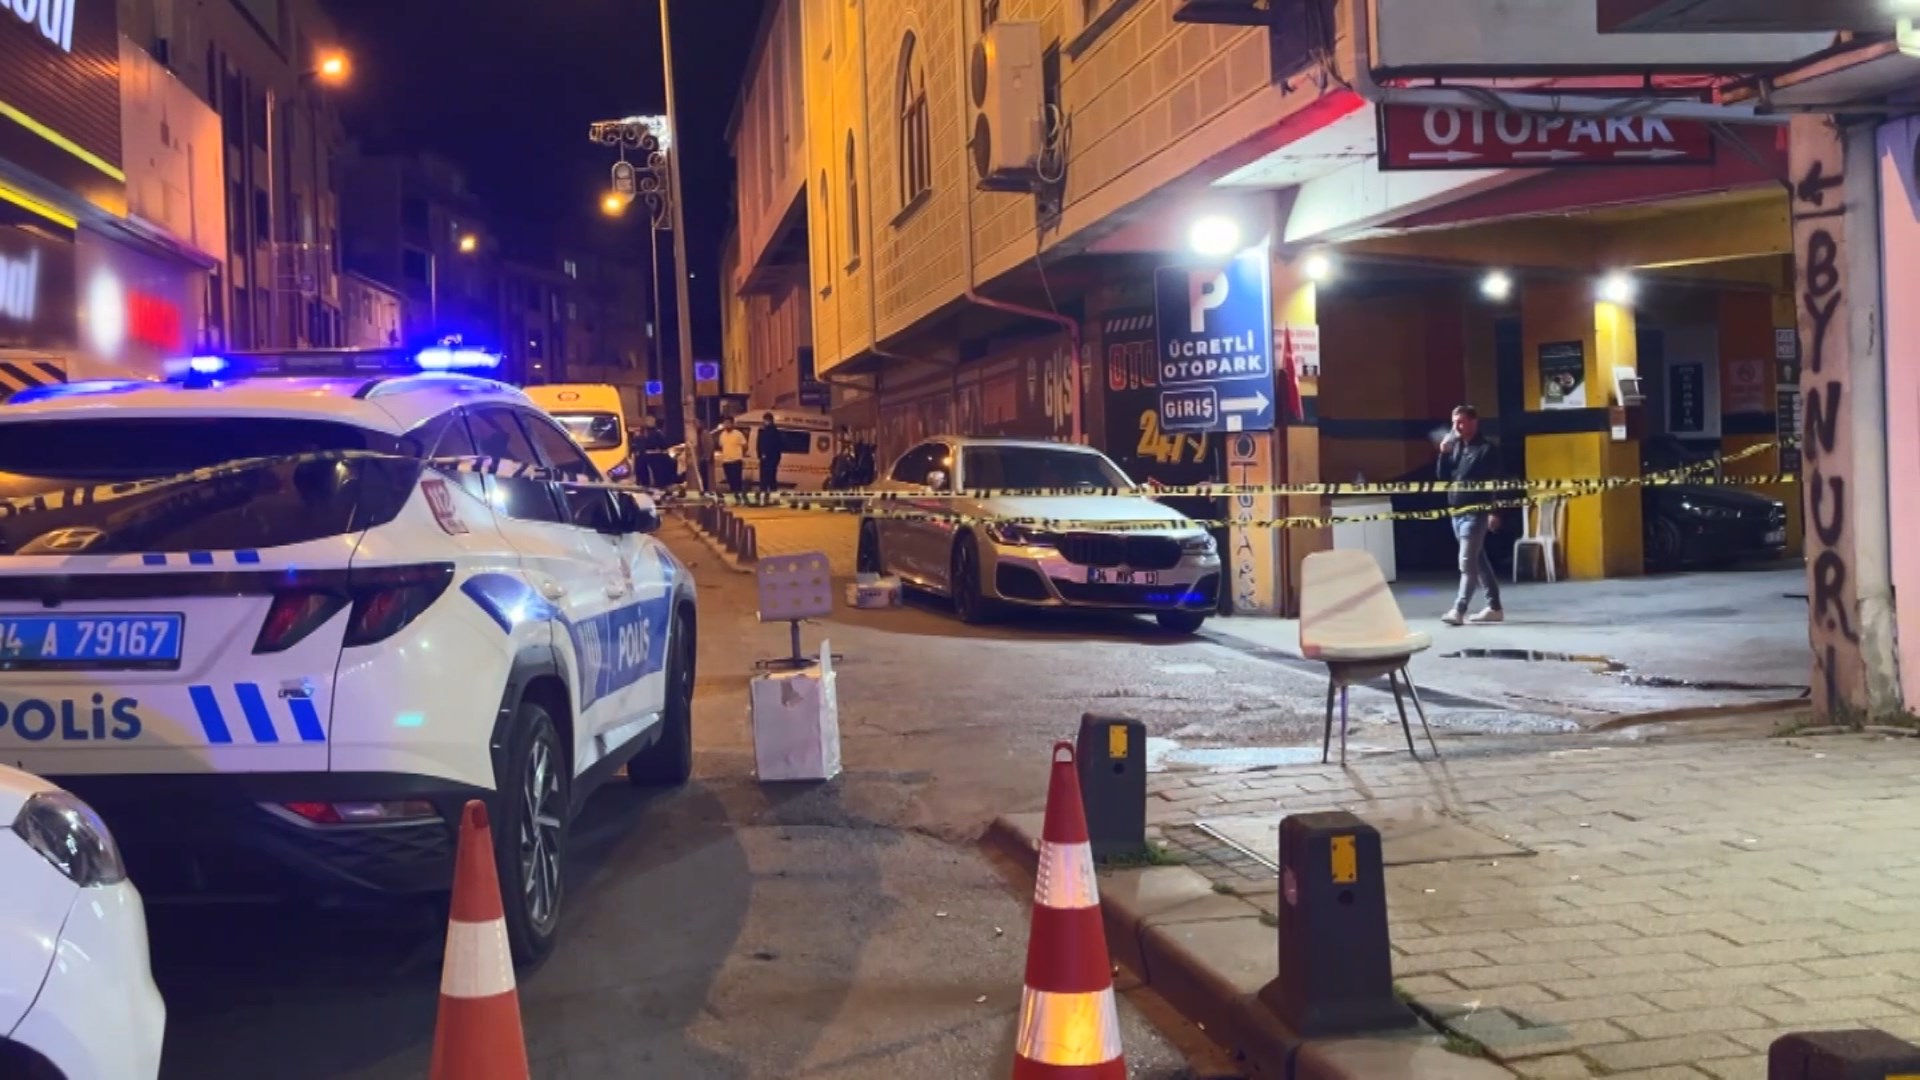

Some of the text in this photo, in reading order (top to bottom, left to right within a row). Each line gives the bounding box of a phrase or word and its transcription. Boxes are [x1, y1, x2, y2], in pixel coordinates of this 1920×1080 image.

[1423, 105, 1675, 146] OTOPARK
[1188, 270, 1229, 332] P
[1169, 329, 1255, 358] ÜCRETLİ
[1164, 354, 1263, 378] OTOPARK
[1165, 397, 1213, 418] GİRİŞ
[0, 620, 169, 657] 4 A 79167
[618, 605, 650, 672] POLİS
